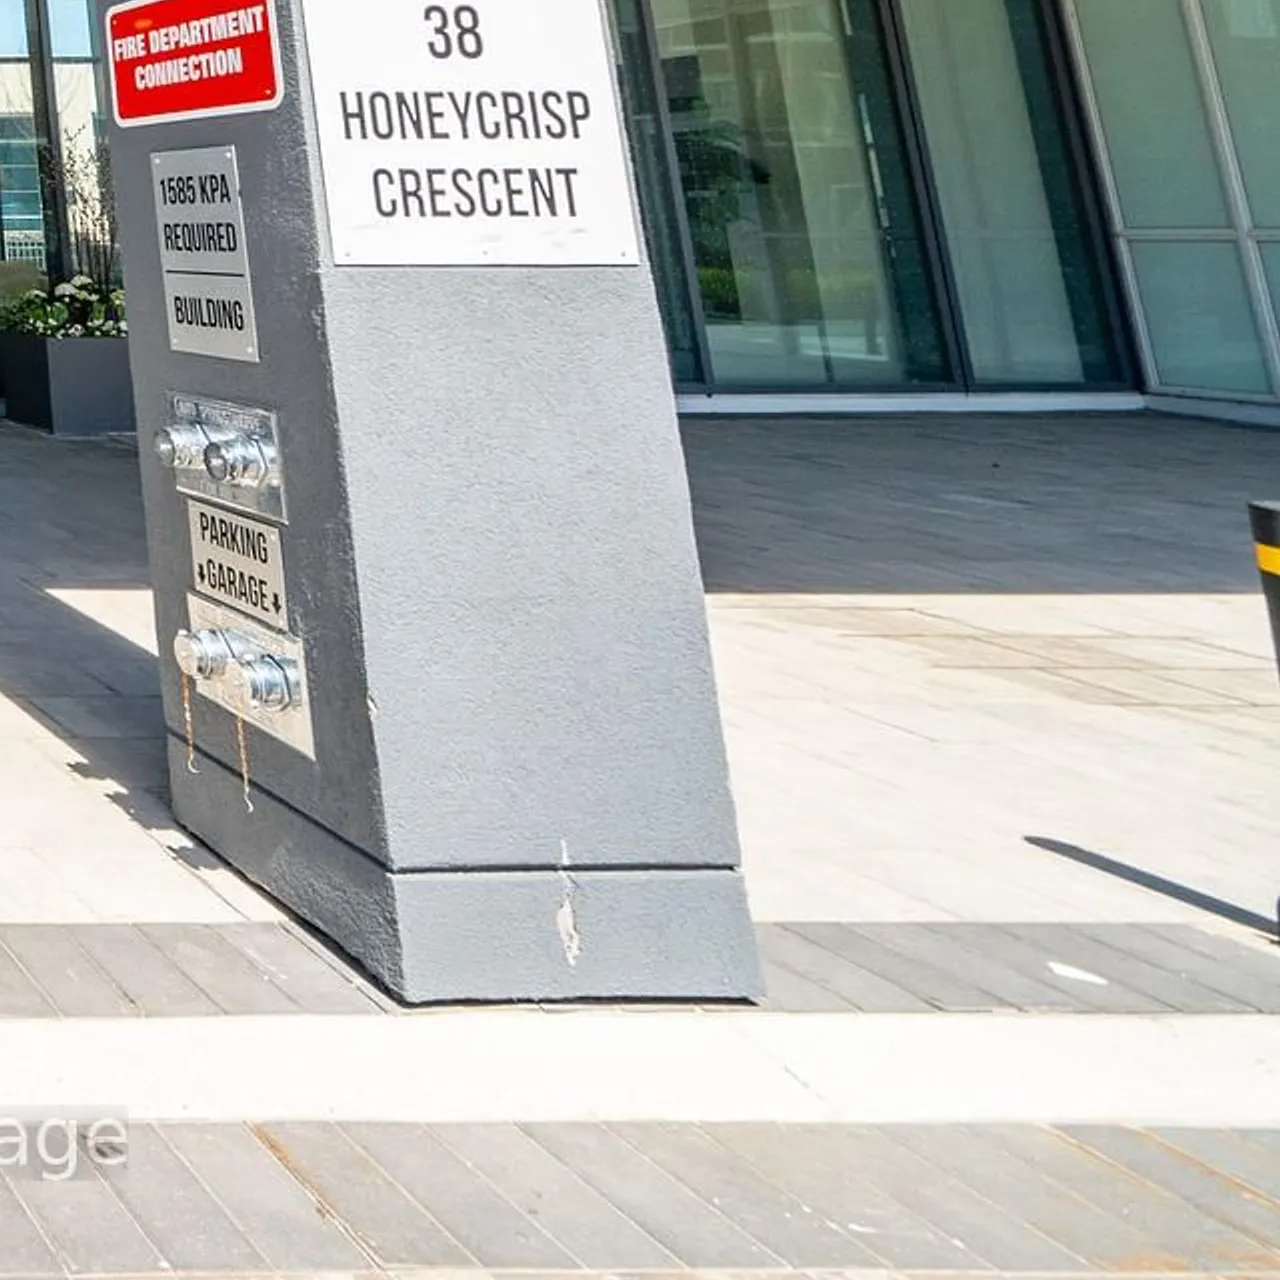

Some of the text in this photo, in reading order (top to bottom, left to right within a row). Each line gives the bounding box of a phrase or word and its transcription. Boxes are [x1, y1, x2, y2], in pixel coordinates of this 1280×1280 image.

[114, 5, 264, 62] FIRE DEPARTMENT
[423, 5, 484, 60] 38
[134, 47, 242, 90] CONNECTION
[339, 91, 591, 140] HONEYCRISP
[160, 175, 231, 206] 1585 KPA
[372, 168, 578, 218] CRESCENT
[164, 222, 237, 253] REQUIRED
[173, 295, 244, 332] BUILDING
[199, 511, 268, 564] PARKING
[206, 558, 269, 612] GARAGE
